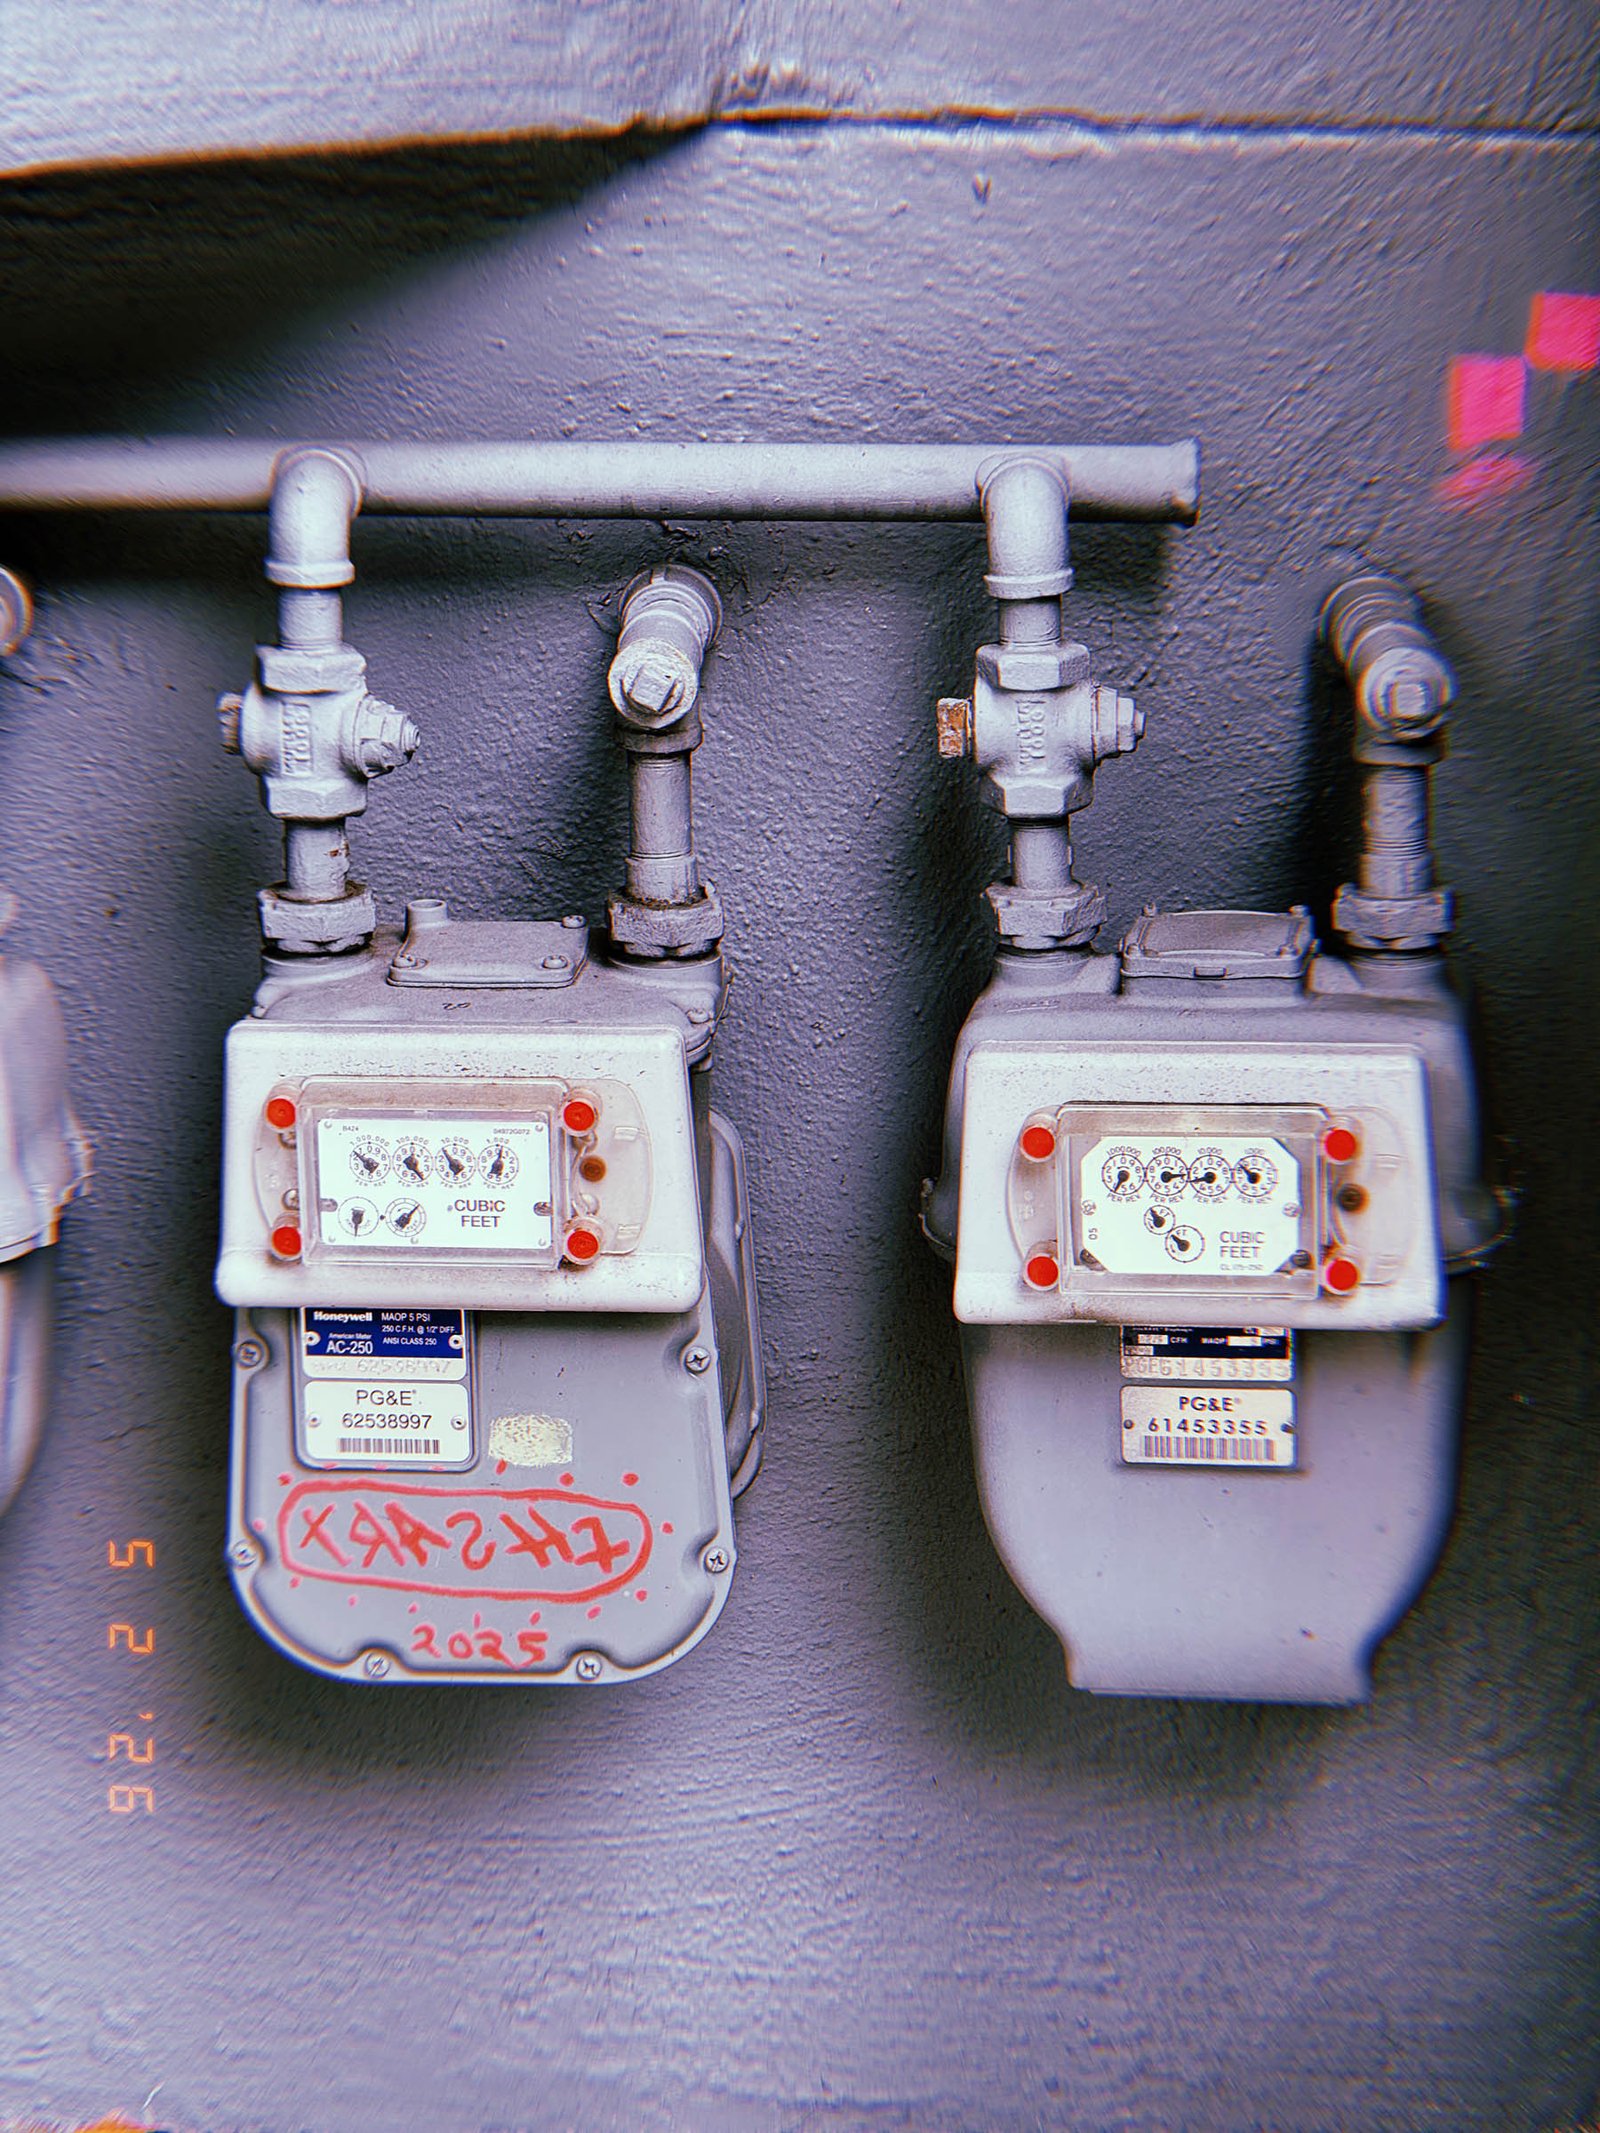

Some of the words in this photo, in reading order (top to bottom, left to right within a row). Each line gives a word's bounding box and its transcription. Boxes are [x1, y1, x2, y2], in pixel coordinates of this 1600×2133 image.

[454, 1199, 506, 1213] CUBIC
[461, 1215, 501, 1228] FEET
[1219, 1231, 1265, 1244] CUBIC
[1220, 1245, 1262, 1258] FEET
[313, 1311, 373, 1323] Honeywell
[381, 1312, 408, 1322] MAOP
[408, 1312, 415, 1322] 5
[416, 1312, 431, 1322] PSI
[381, 1325, 395, 1333] 250
[417, 1325, 425, 1335] @
[325, 1340, 374, 1354] AC-250
[382, 1337, 400, 1345] ANSI
[400, 1337, 424, 1345] CLASS
[424, 1338, 438, 1346] 250
[356, 1389, 413, 1406] PG&E
[1179, 1396, 1234, 1412] PG&E
[342, 1412, 432, 1430] 62538997
[1148, 1418, 1268, 1435] 61453355
[410, 1624, 548, 1669] 2025
